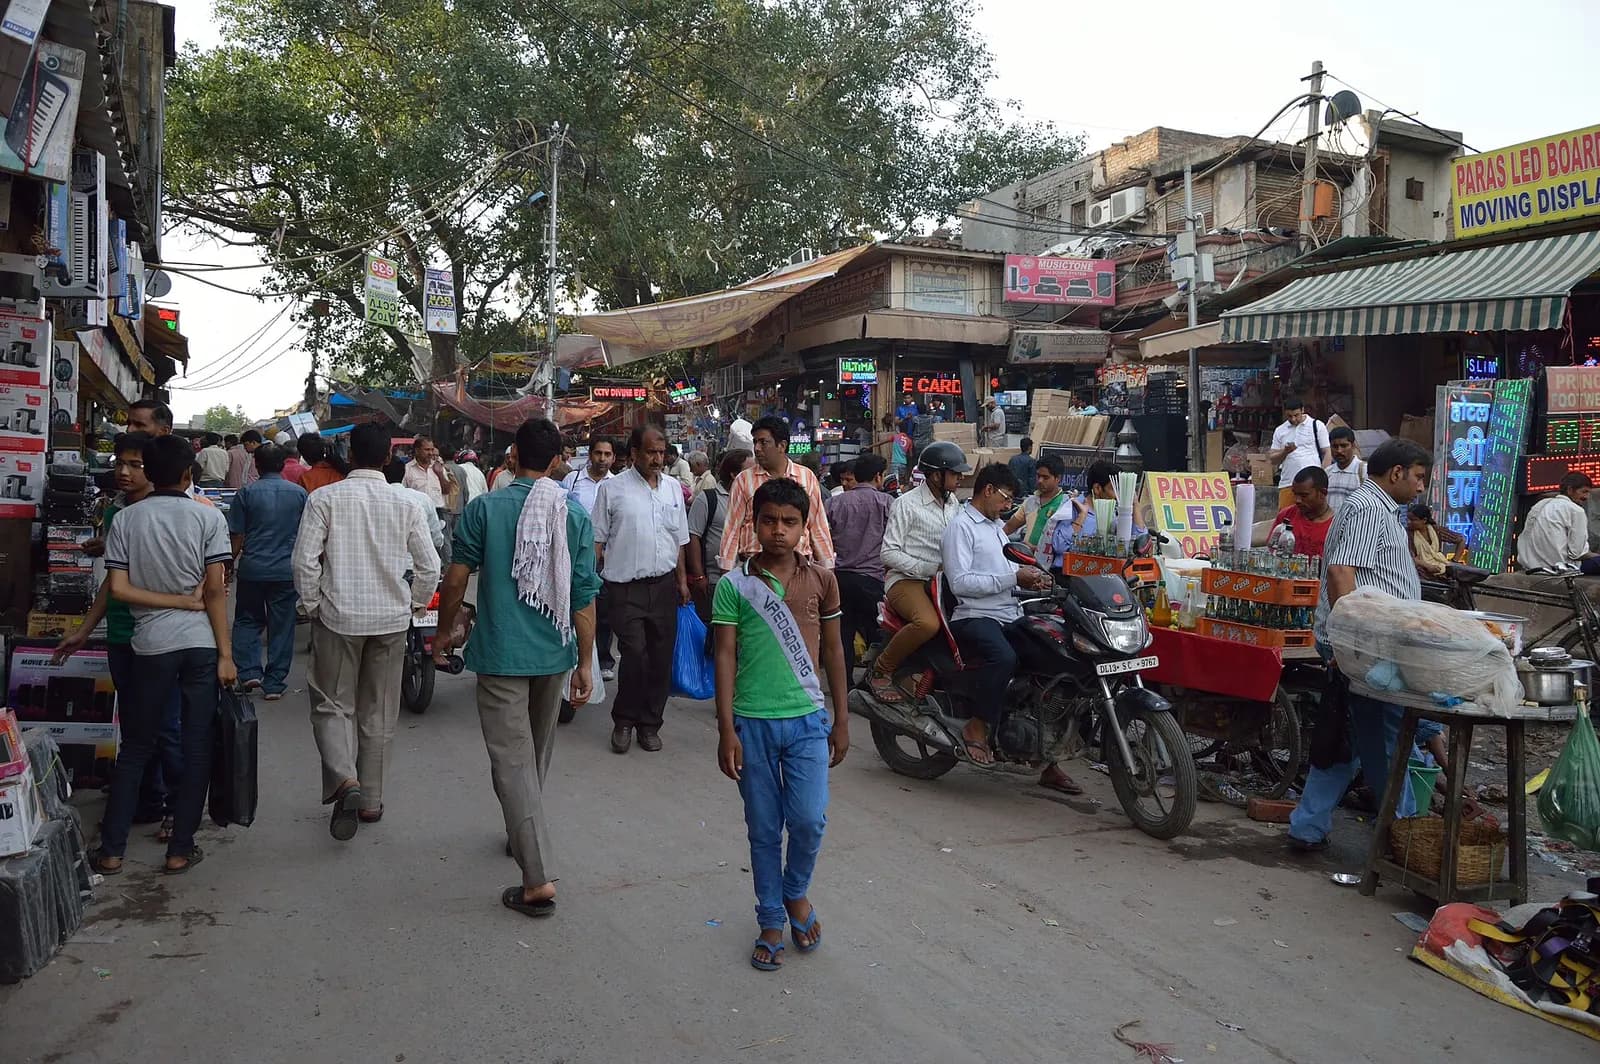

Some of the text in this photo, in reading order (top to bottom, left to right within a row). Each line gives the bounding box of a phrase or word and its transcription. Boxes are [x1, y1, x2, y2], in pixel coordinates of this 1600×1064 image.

[1456, 154, 1506, 198] PARAS
[1510, 146, 1542, 186] LED
[1460, 191, 1532, 229] MOVING
[1038, 259, 1094, 272] MUSICTONE
[369, 298, 396, 311] CCTV
[1469, 358, 1496, 374] SLIM
[593, 387, 610, 397] CCTV
[1156, 476, 1229, 501] PARAS
[1161, 504, 1235, 532] LED
[1213, 575, 1271, 596] Crush Crush Crush
